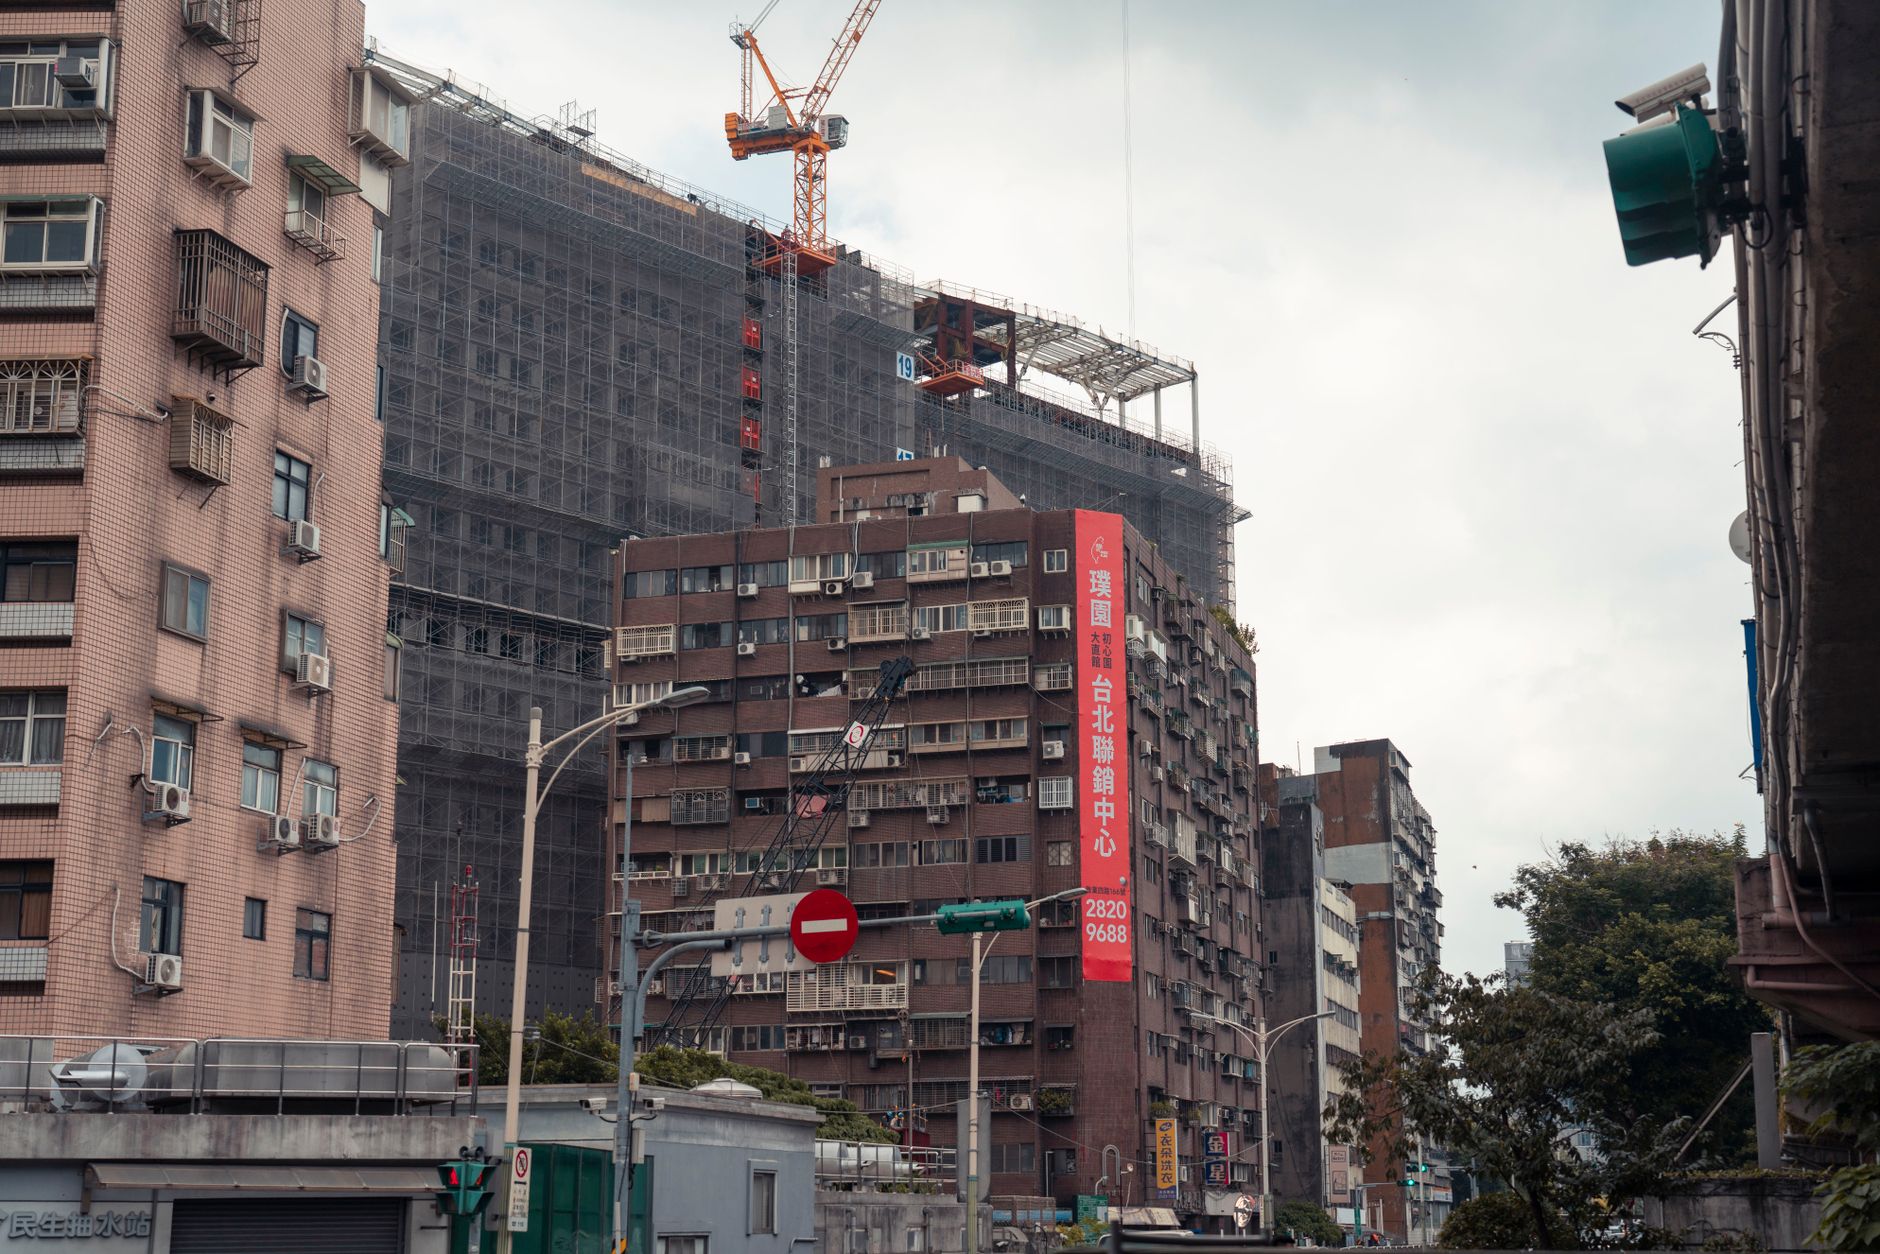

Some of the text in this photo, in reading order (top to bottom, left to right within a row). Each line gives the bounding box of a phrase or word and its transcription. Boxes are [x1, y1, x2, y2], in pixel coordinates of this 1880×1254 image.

[899, 354, 912, 378] 19
[1089, 570, 1112, 628] 璞園
[1091, 674, 1116, 858] 台北聯銷中心
[1086, 899, 1127, 919] 2820
[1086, 923, 1127, 943] 9688
[1160, 1134, 1173, 1184] 衣朵洗衣
[1208, 1136, 1225, 1182] 金星
[9, 1211, 152, 1238] 民生抽水站
